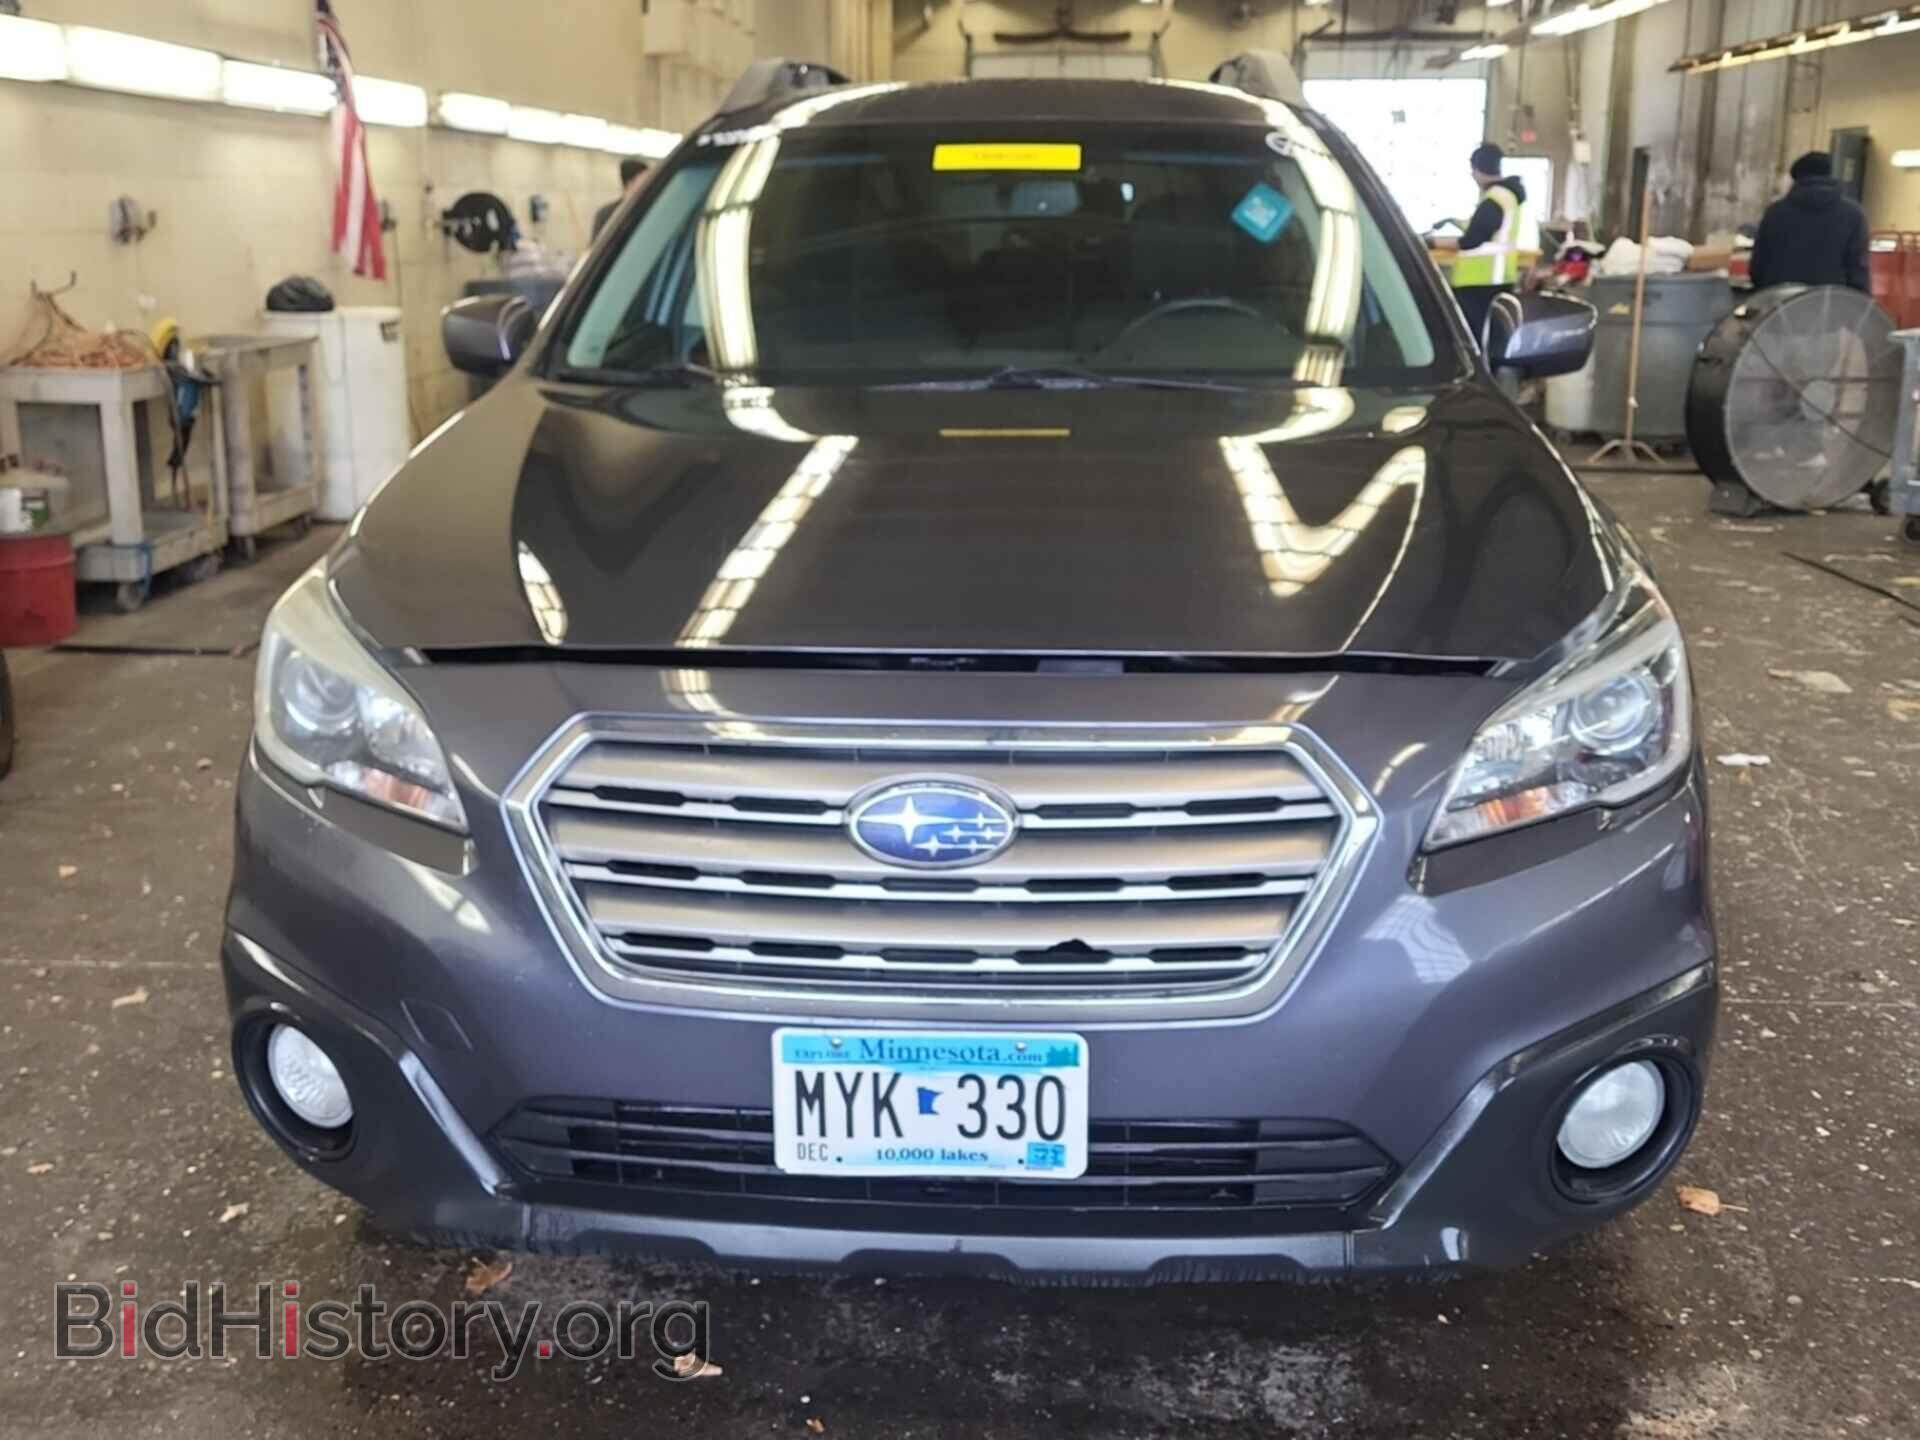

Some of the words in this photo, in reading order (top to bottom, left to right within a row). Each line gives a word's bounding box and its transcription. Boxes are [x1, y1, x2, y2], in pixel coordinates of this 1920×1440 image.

[795, 1071, 903, 1138] MYK
[957, 1073, 1066, 1141] 330
[797, 1142, 829, 1161] DEC
[876, 1148, 934, 1163] 10,000
[941, 1148, 989, 1162] lakes
